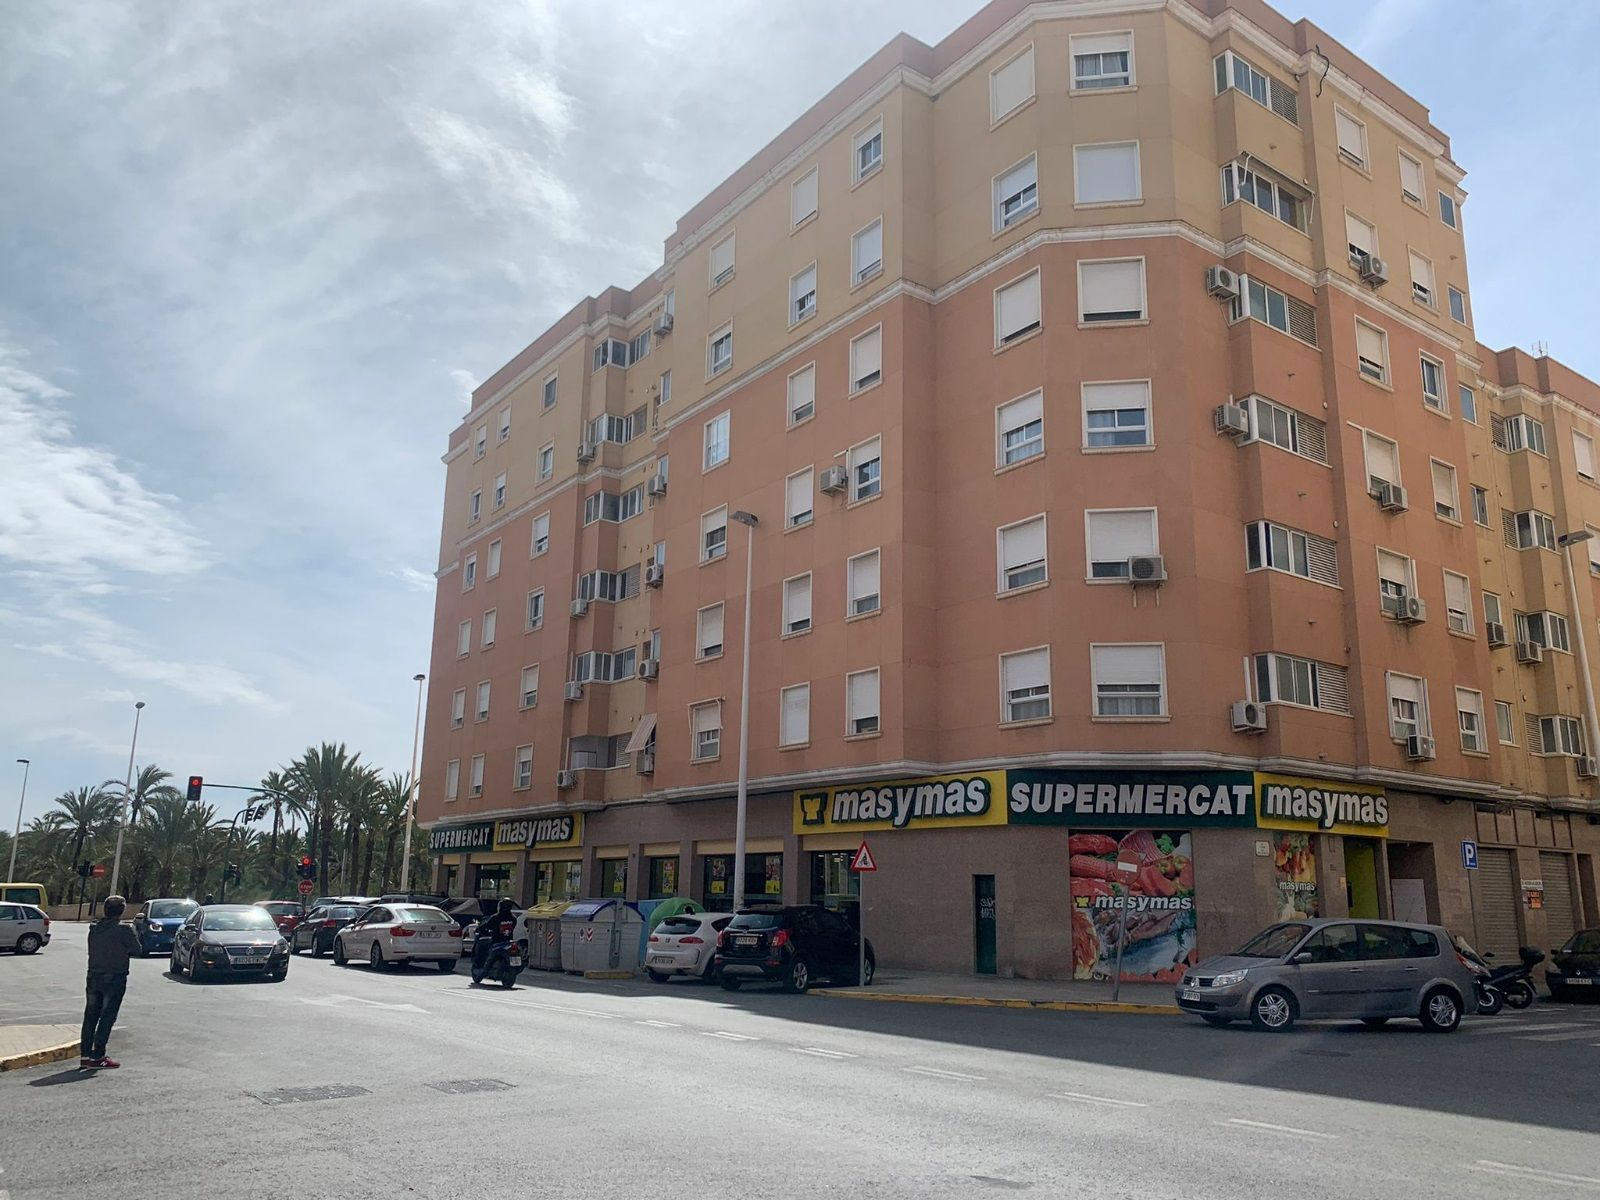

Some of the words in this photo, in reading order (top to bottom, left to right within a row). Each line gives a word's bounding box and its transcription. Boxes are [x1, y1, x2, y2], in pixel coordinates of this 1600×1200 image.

[832, 778, 986, 826] masymas
[1010, 781, 1253, 816] SUPERMERCAT
[1266, 784, 1389, 828] masymas
[429, 826, 490, 849] SUPERMERCAT
[497, 816, 571, 847] masymas
[1464, 843, 1475, 866] P
[1280, 880, 1316, 892] masymas
[1095, 894, 1192, 912] masymas
